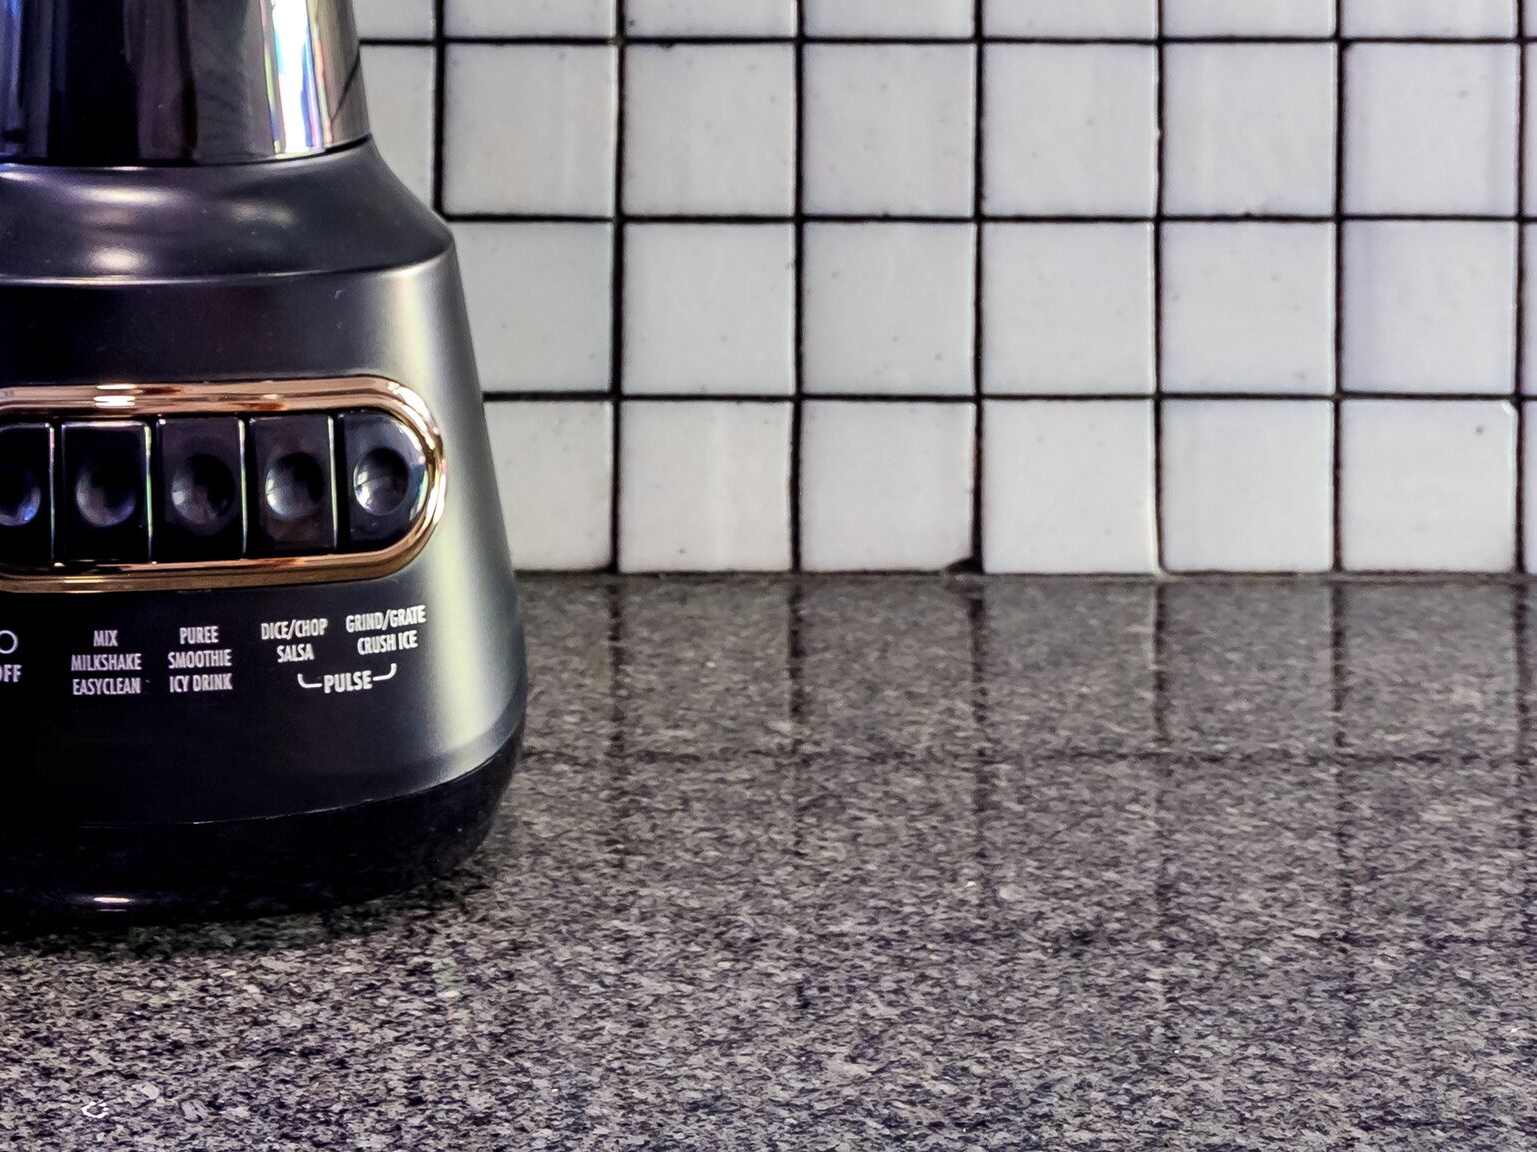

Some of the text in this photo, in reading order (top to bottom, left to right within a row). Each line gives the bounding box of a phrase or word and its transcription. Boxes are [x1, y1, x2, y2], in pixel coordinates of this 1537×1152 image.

[345, 604, 427, 633] GRIND/GRATE
[93, 630, 118, 647] MIX
[179, 625, 220, 645] PUREE
[261, 618, 329, 640] DICE/CHOP
[357, 630, 418, 655] CRUSH ICE
[70, 653, 142, 671] MILKSHAKE
[168, 649, 232, 669] SMOOTHIE
[276, 643, 315, 663] SALSA
[72, 677, 141, 695] EASYCLEAN
[169, 673, 233, 693] ICY DRINK
[324, 670, 372, 694] PULSE
